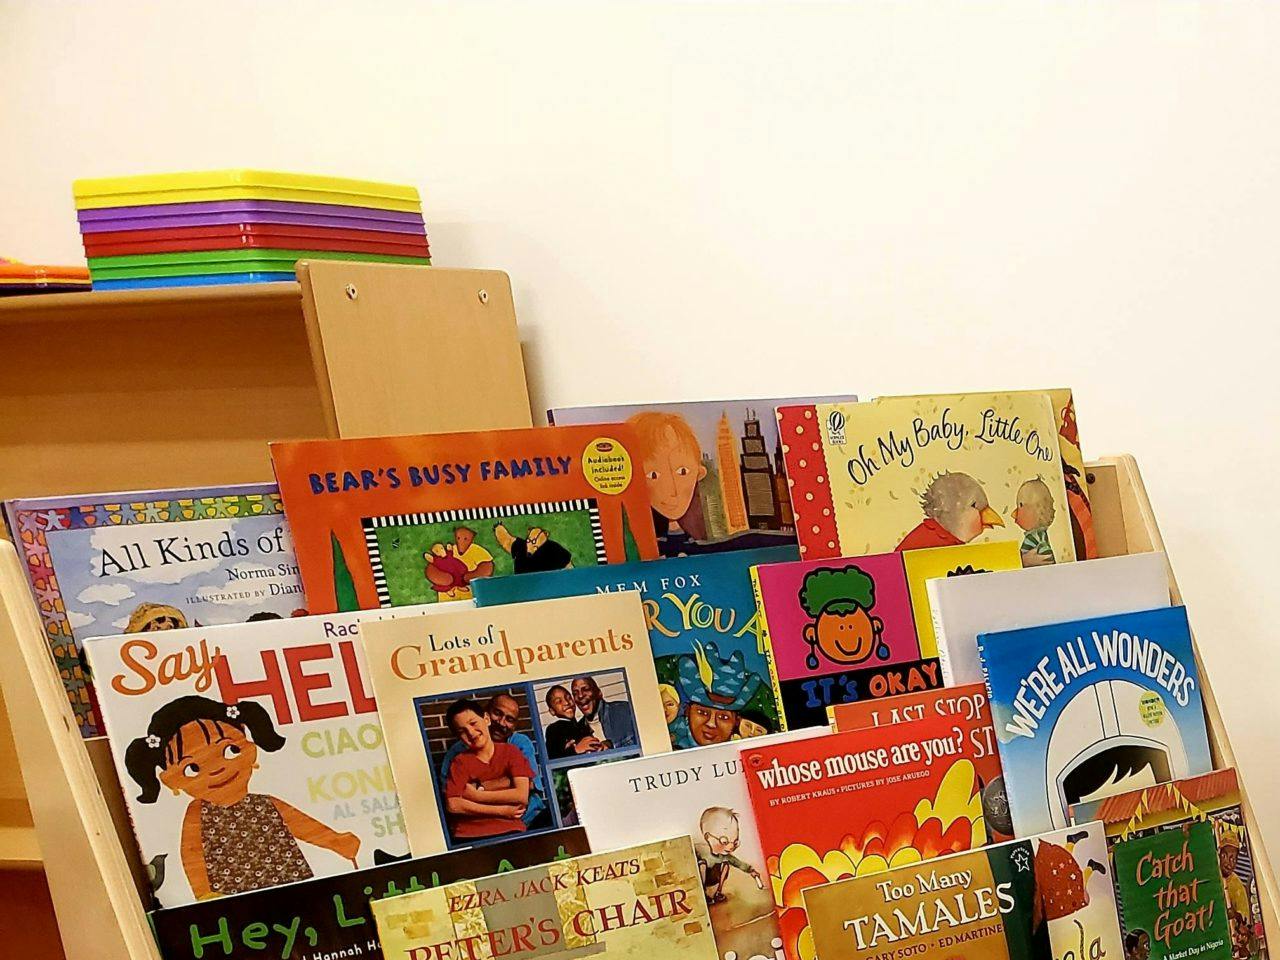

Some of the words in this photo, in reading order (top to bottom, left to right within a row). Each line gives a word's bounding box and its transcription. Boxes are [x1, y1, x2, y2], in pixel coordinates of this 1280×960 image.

[848, 445, 880, 485] Oh
[877, 431, 915, 468] My
[913, 408, 969, 450] Baby,
[975, 409, 1024, 445] Little
[1026, 431, 1053, 462] One
[309, 467, 401, 495] BEAR'S
[408, 463, 471, 488] BUSY
[480, 455, 572, 482] FAMILY
[99, 543, 151, 577] All
[153, 531, 250, 567] Kinds
[257, 527, 287, 554] of
[185, 591, 251, 605] ILLUSTRATED
[254, 589, 266, 598] BY
[268, 582, 304, 596] Dian
[225, 567, 276, 581] Norma
[661, 574, 702, 590] FOX
[323, 619, 361, 638] Rac
[661, 592, 736, 633] YOU
[390, 629, 634, 681] Grandparents
[428, 633, 471, 652] Lots
[478, 625, 494, 645] of
[111, 638, 221, 696] Say
[801, 675, 859, 708] IT'S
[869, 662, 938, 697] OKAY
[1006, 656, 1064, 738] WE'RE
[1056, 636, 1097, 684] ALL
[1091, 630, 1195, 707] WONDERS
[935, 694, 985, 721] STOP
[301, 723, 384, 758] CIAO
[757, 759, 822, 790] whose
[825, 748, 889, 778] mouse
[891, 741, 921, 765] are
[921, 728, 964, 765] you?
[629, 766, 702, 793] TRUDY
[770, 799, 780, 807] BY
[781, 792, 811, 804] ROBERT
[812, 787, 836, 799] KRAUS
[840, 780, 875, 793] PICTURES
[875, 777, 885, 786] BY
[1136, 840, 1194, 886] Catch
[448, 889, 507, 914] EZRA
[513, 871, 569, 900] JACK
[576, 858, 641, 887] KEATS
[876, 880, 914, 903] Too
[915, 869, 973, 896] Many
[1153, 878, 1210, 910] that
[572, 888, 693, 939] CHAIR
[844, 882, 1015, 951] TAMALES
[1154, 900, 1215, 949] Goat!
[190, 917, 318, 960] Hey,
[897, 943, 928, 959] SOTO
[938, 935, 954, 949] ED
[1188, 947, 1200, 956] Day
[1200, 944, 1206, 952] in
